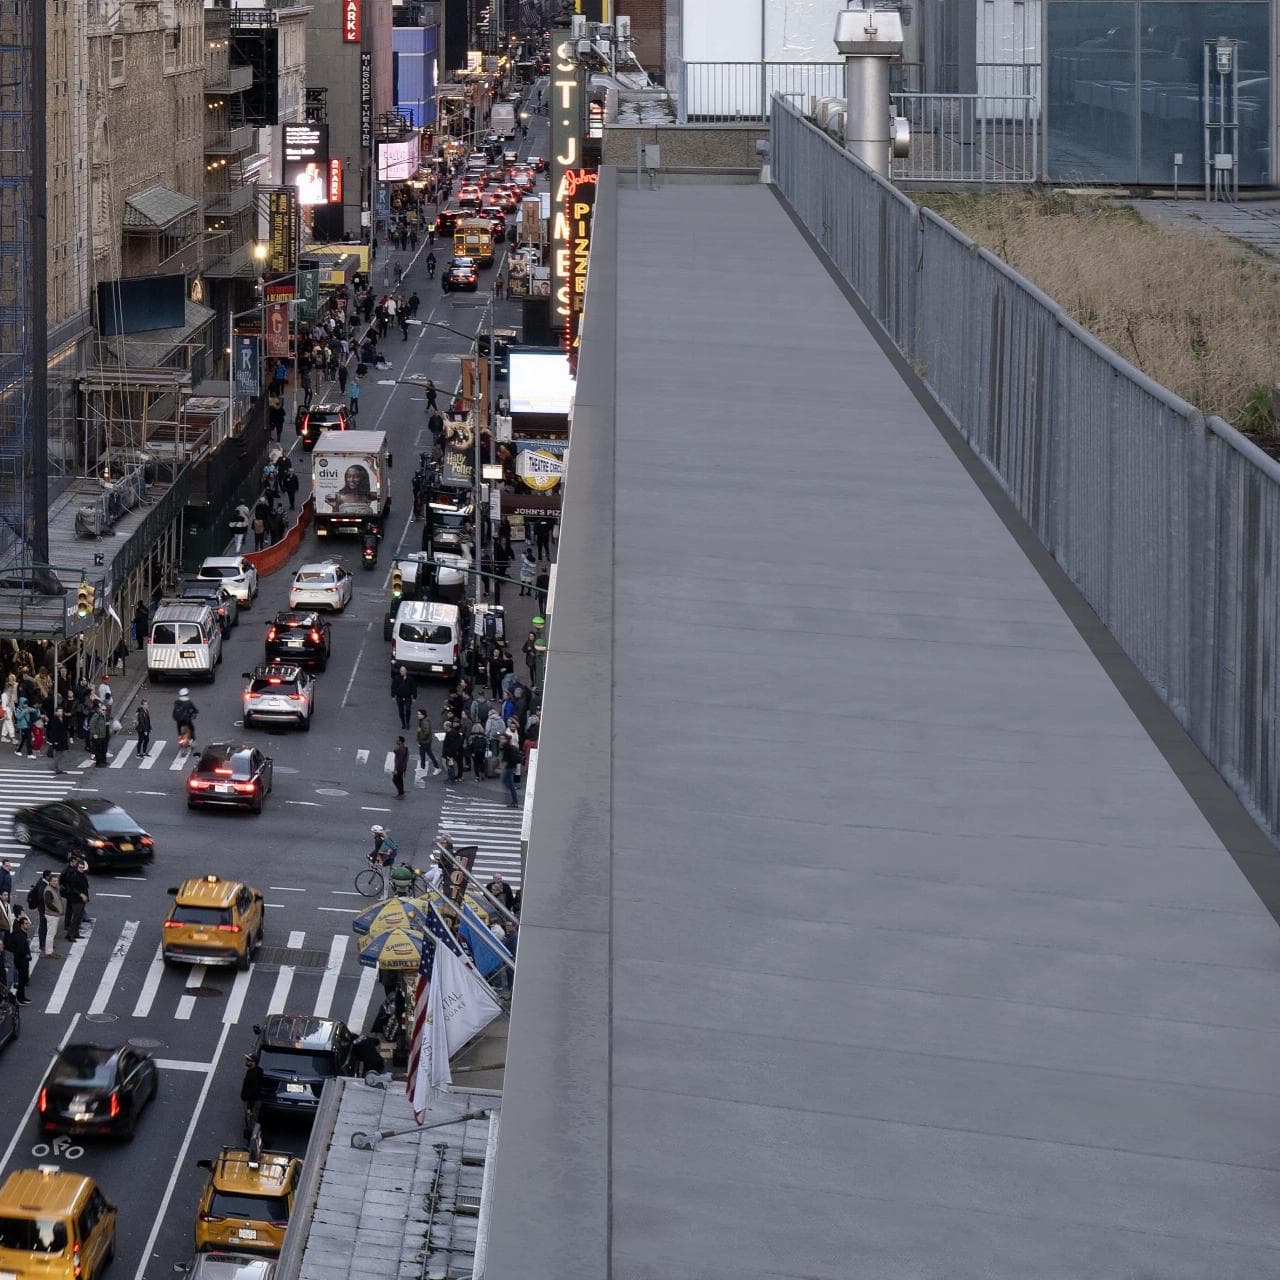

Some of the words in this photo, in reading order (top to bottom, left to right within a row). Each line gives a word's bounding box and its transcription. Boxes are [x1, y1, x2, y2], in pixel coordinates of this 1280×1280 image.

[362, 54, 370, 101] MINSKOFF
[362, 105, 370, 146] THEATRE
[319, 469, 338, 478] divi
